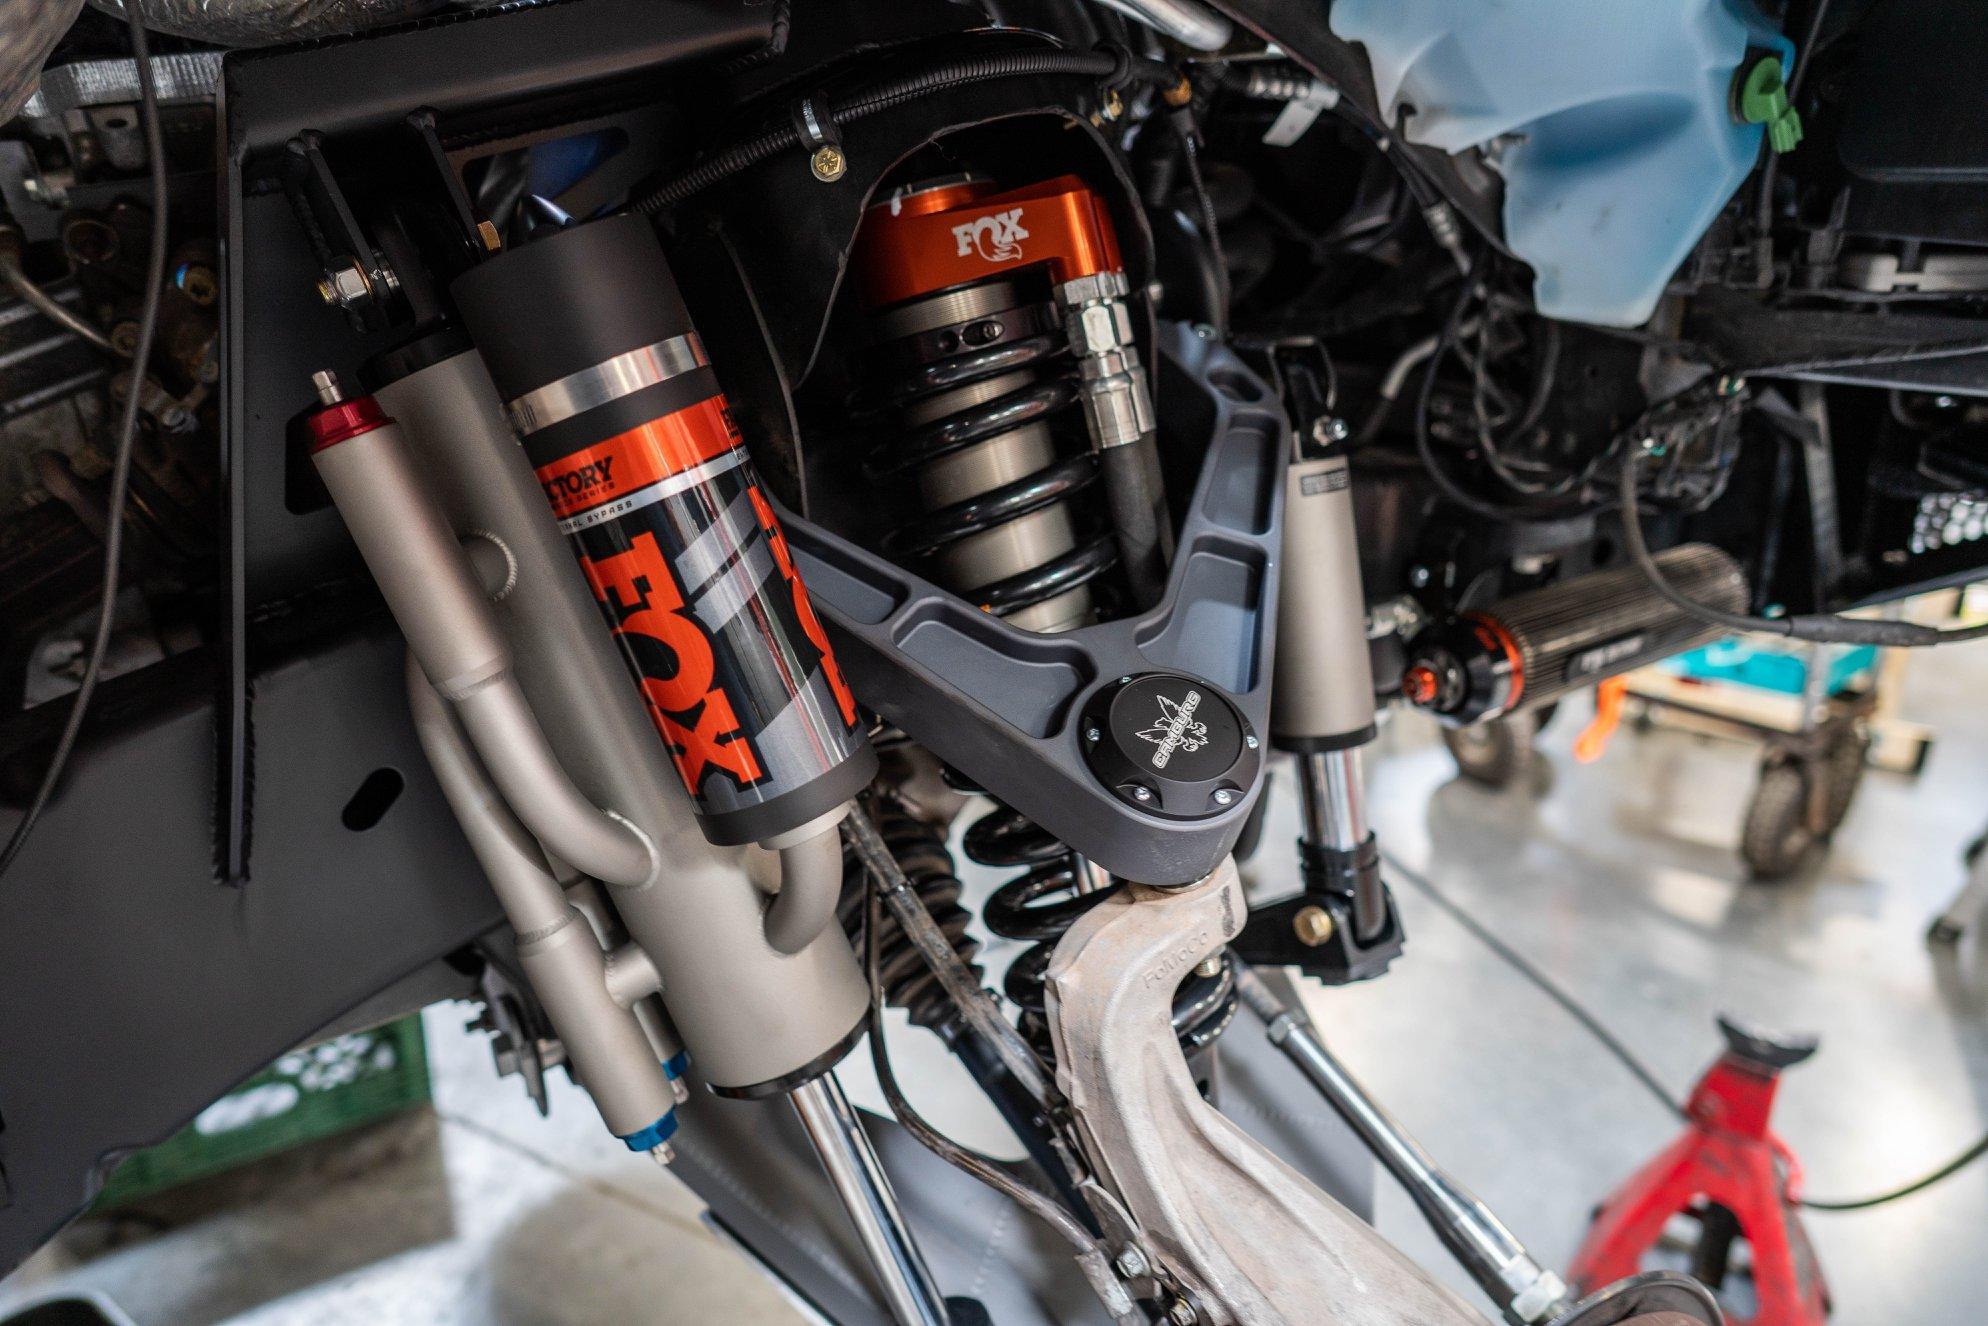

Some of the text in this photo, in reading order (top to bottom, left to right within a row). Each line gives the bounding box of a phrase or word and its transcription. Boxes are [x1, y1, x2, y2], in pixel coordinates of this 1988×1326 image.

[952, 208, 1029, 262] FOX
[541, 456, 613, 501] CTORY
[586, 500, 633, 523] BYPASS
[580, 531, 762, 796] FOX
[1152, 690, 1201, 769] CAMBURG
[1143, 931, 1208, 989] FoMoCo
